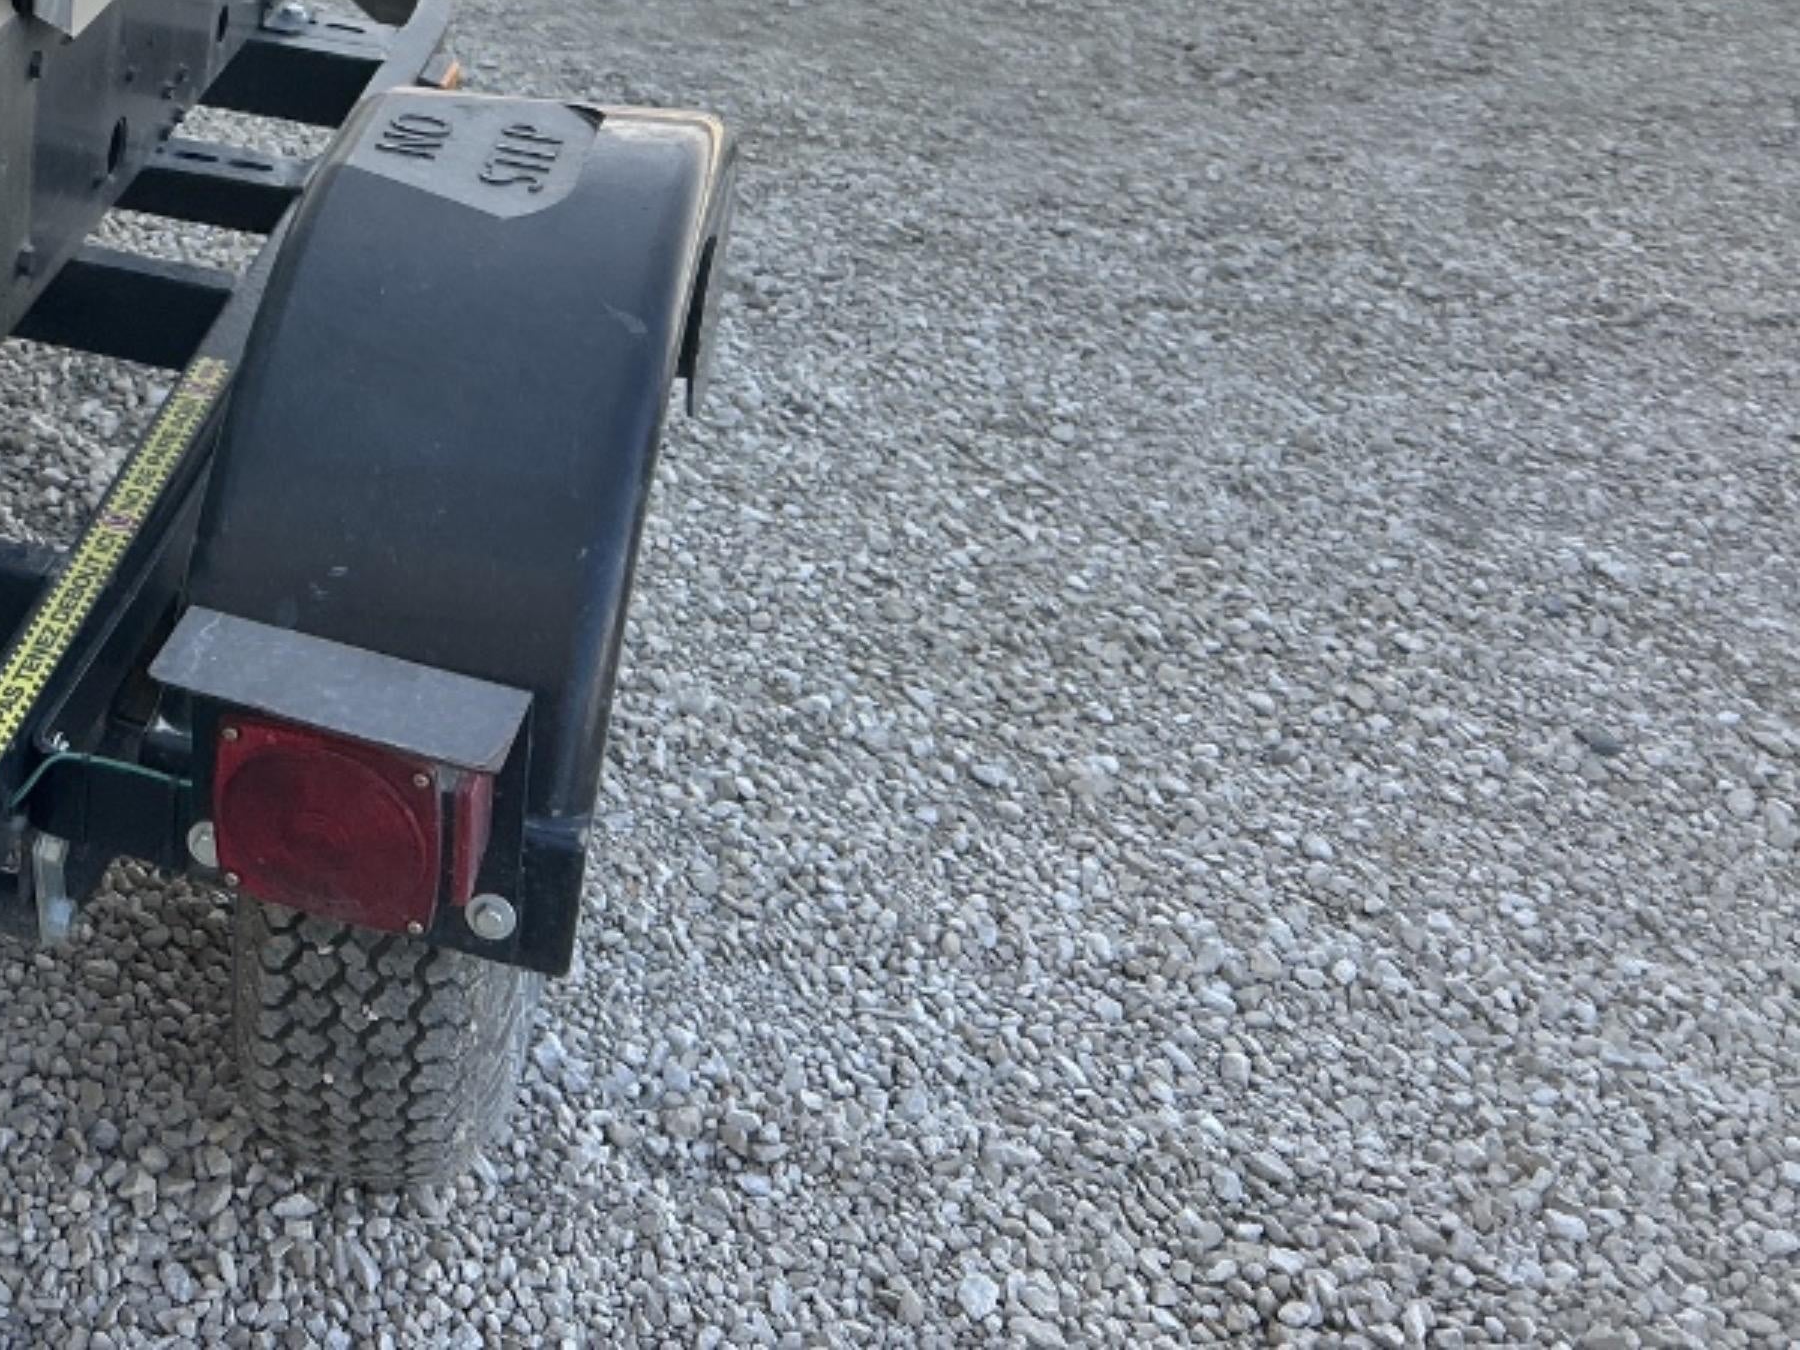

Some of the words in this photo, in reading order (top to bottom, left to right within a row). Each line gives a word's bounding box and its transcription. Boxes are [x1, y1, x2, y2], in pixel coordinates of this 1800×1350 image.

[374, 113, 451, 161] NO
[14, 626, 62, 685] TENEZ
[49, 557, 106, 630] DEBOUT
